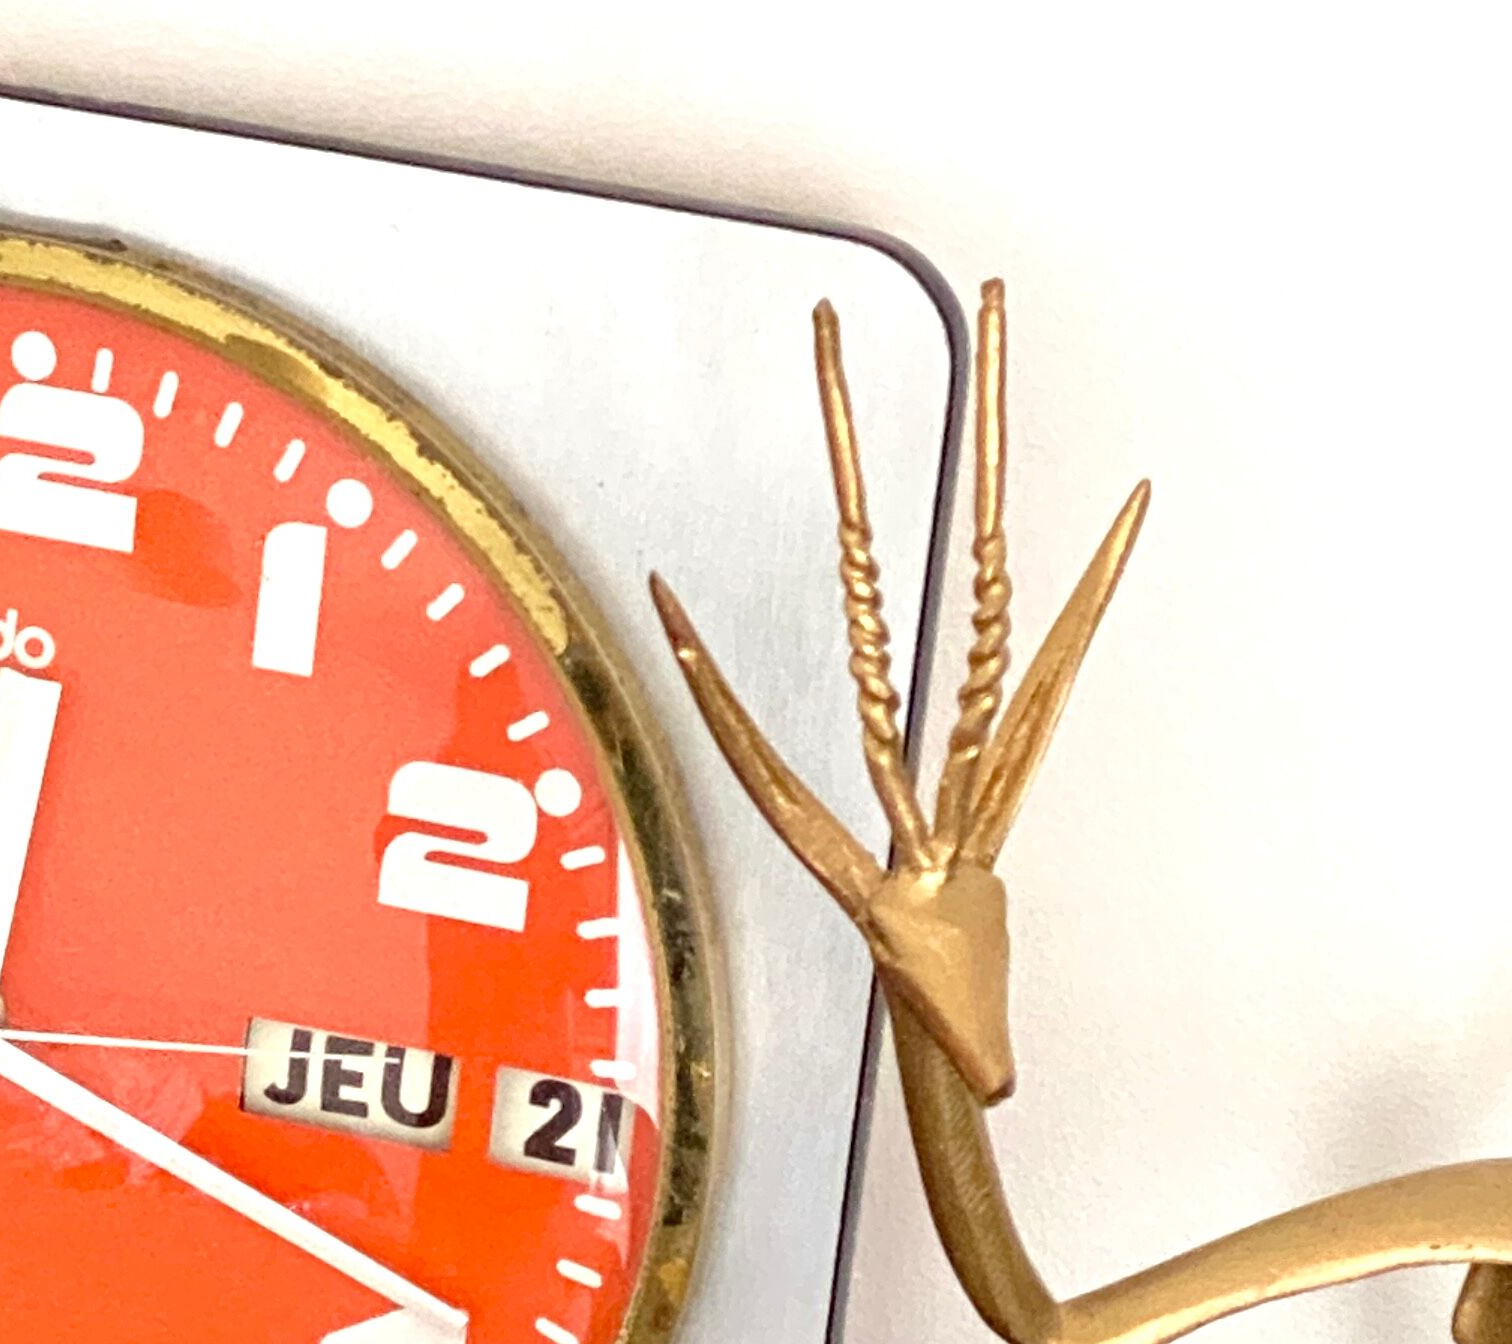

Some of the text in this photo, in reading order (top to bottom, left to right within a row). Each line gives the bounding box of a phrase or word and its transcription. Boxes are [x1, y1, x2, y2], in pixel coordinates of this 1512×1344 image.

[252, 521, 327, 676] 1
[378, 760, 538, 932] 2
[262, 1027, 623, 1173] JEU 21
